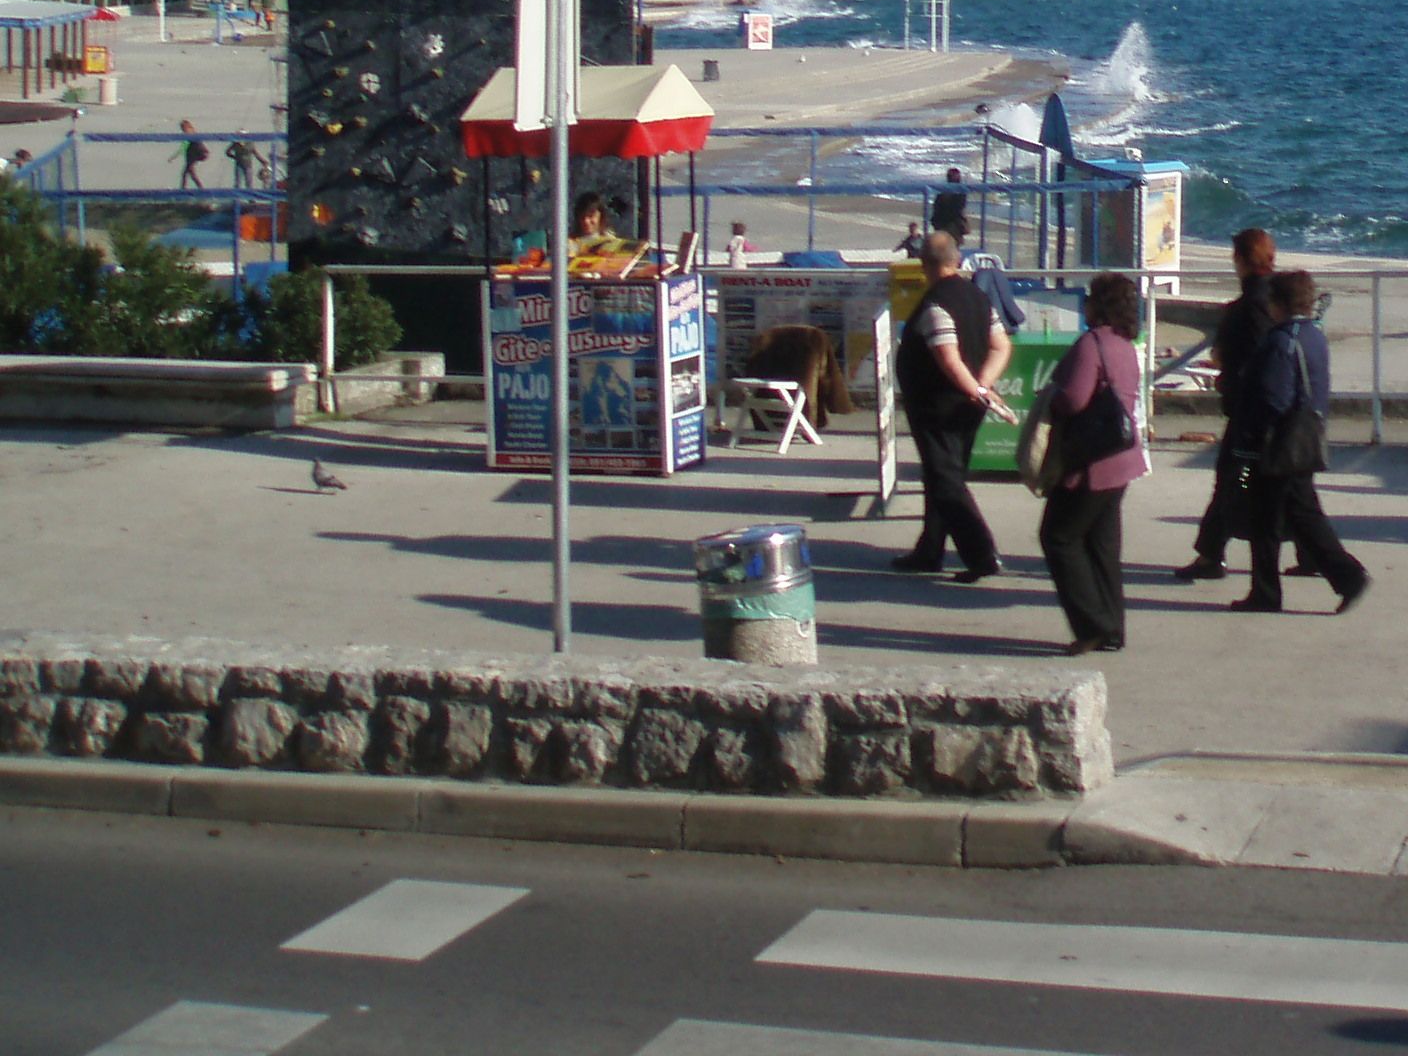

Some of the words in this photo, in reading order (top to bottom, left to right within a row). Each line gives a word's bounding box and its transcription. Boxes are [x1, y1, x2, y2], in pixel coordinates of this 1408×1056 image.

[721, 278, 770, 287] RENT-A
[774, 278, 812, 287] BOAT
[495, 337, 538, 362] Gite
[671, 321, 699, 354] PAJO
[499, 372, 549, 400] PAJO
